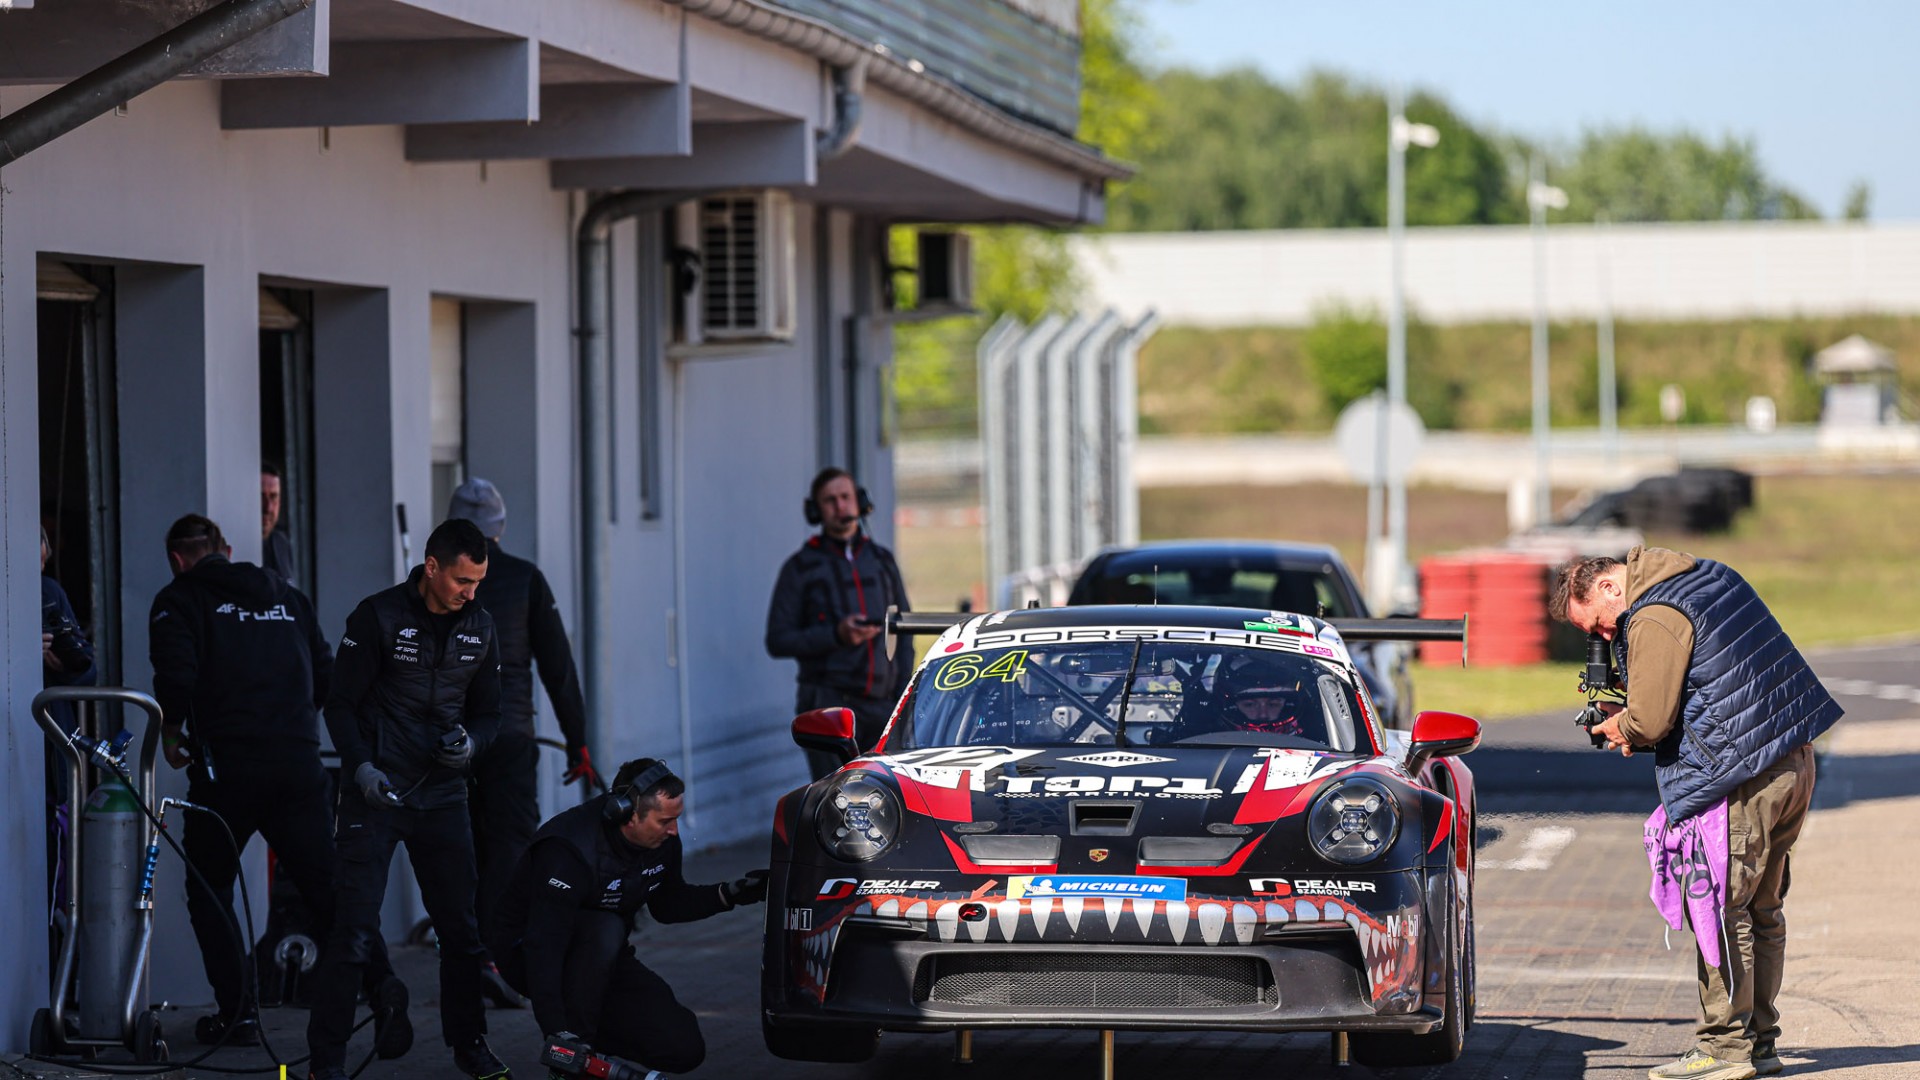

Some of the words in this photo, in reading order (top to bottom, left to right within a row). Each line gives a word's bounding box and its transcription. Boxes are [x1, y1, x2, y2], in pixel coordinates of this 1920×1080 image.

[238, 604, 296, 622] FUEL
[399, 628, 418, 638] 4F
[463, 635, 482, 644] FUEL
[973, 629, 1299, 650] PORSCHE
[934, 650, 1028, 691] 64
[998, 776, 1224, 794] TOP1
[1044, 791, 1172, 799] KARTING
[606, 879, 621, 891] 4F
[858, 879, 941, 890] DEALER
[1059, 882, 1167, 893] MICHELIN
[1294, 879, 1377, 893] DEALER
[1386, 914, 1419, 938] Mobil
[1686, 1056, 1716, 1072] HOKA
